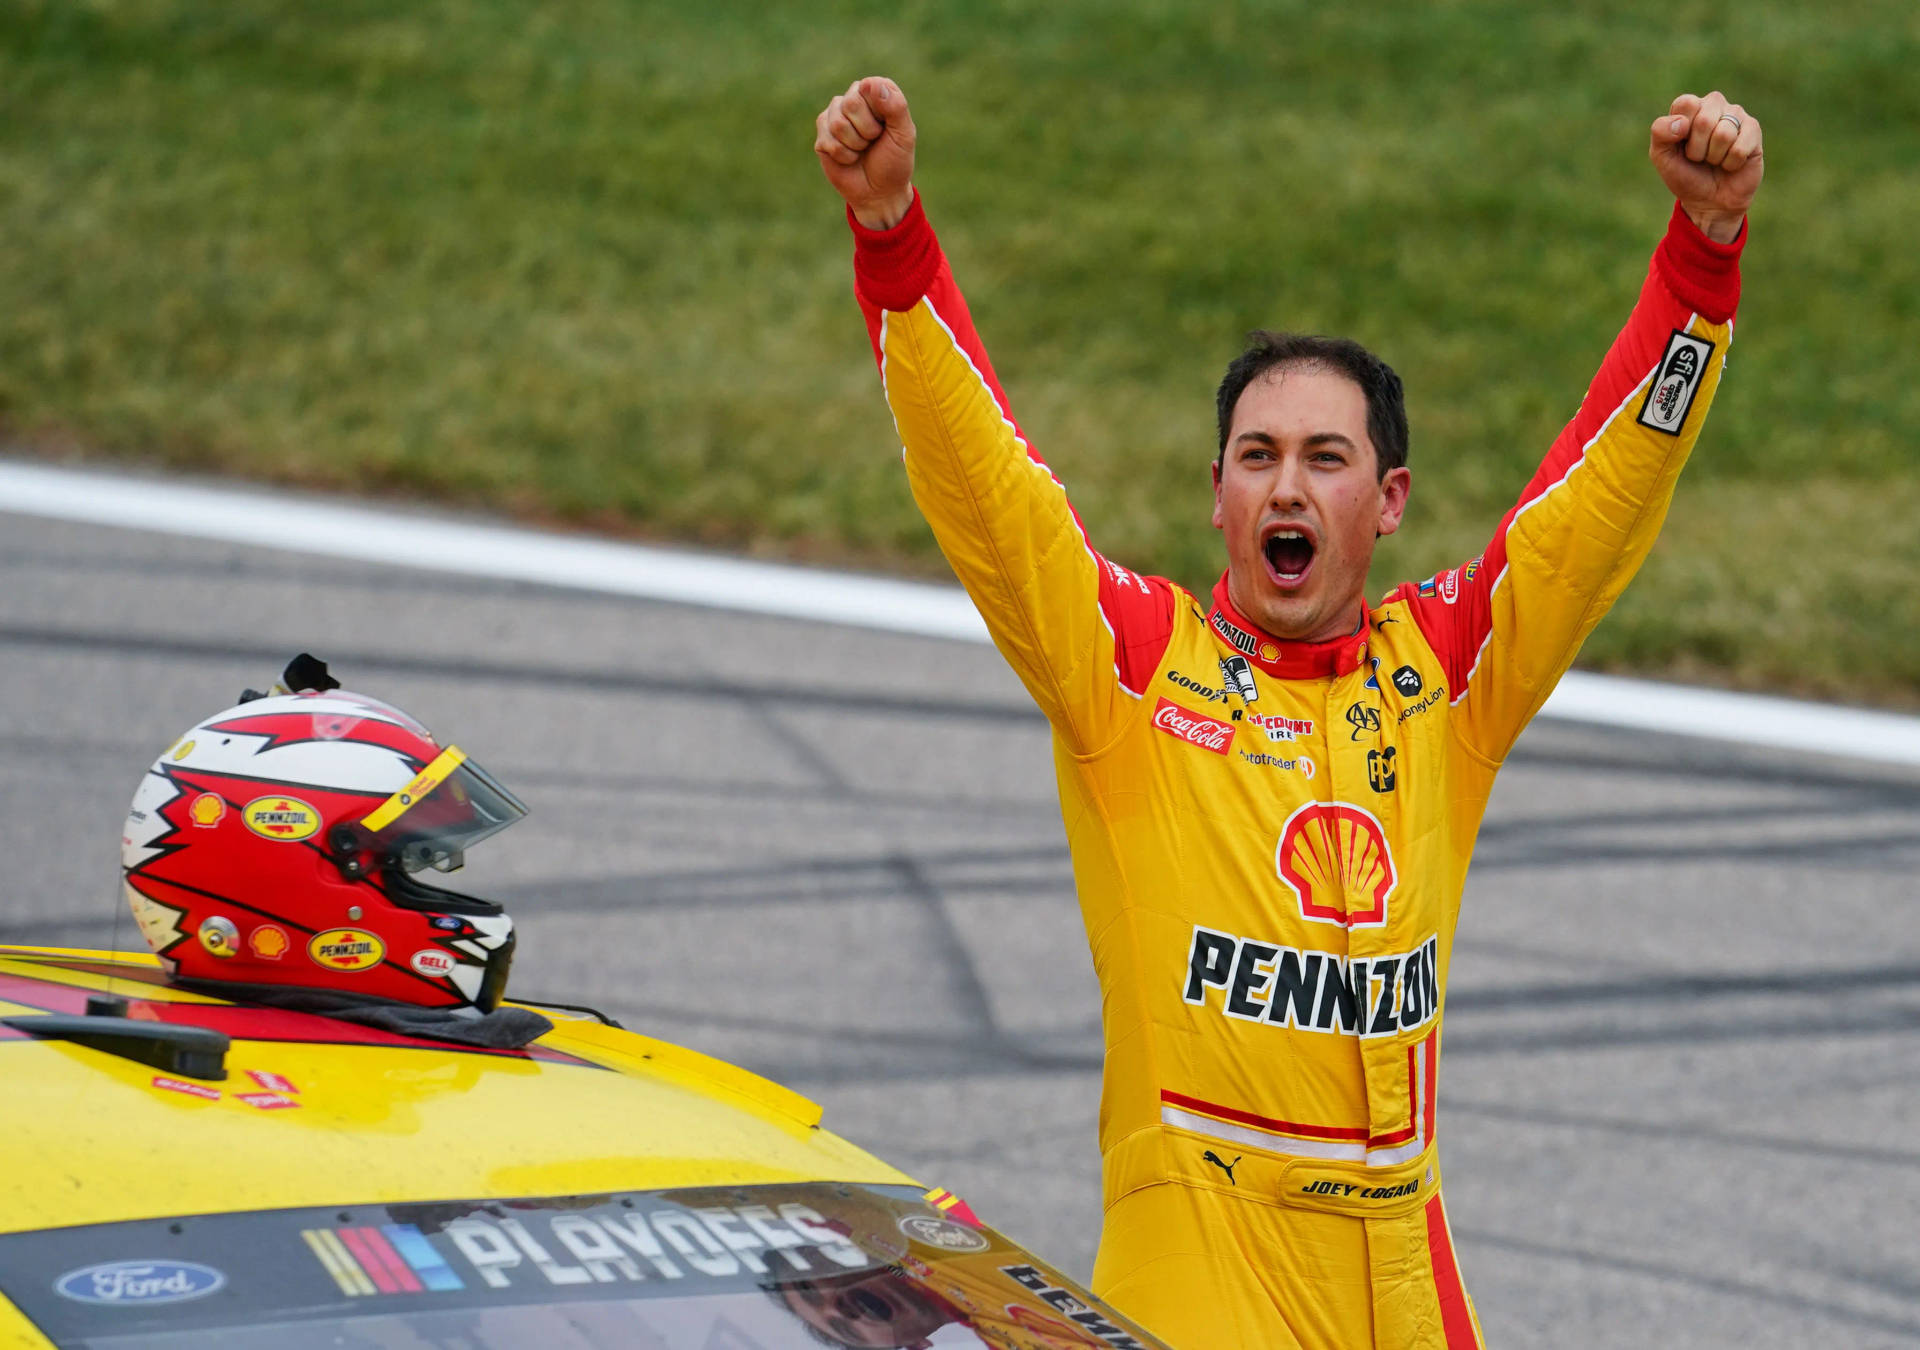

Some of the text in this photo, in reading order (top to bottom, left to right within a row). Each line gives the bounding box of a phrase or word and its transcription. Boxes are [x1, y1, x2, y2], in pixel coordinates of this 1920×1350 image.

[253, 811, 310, 824] PENNZOIL
[319, 942, 374, 957] PENNZOIL
[419, 956, 448, 970] BELL
[1302, 1179, 1419, 1199] JOEY LOGANO
[442, 1203, 869, 1288] PLAYOFFS
[91, 1267, 196, 1301] Ford
